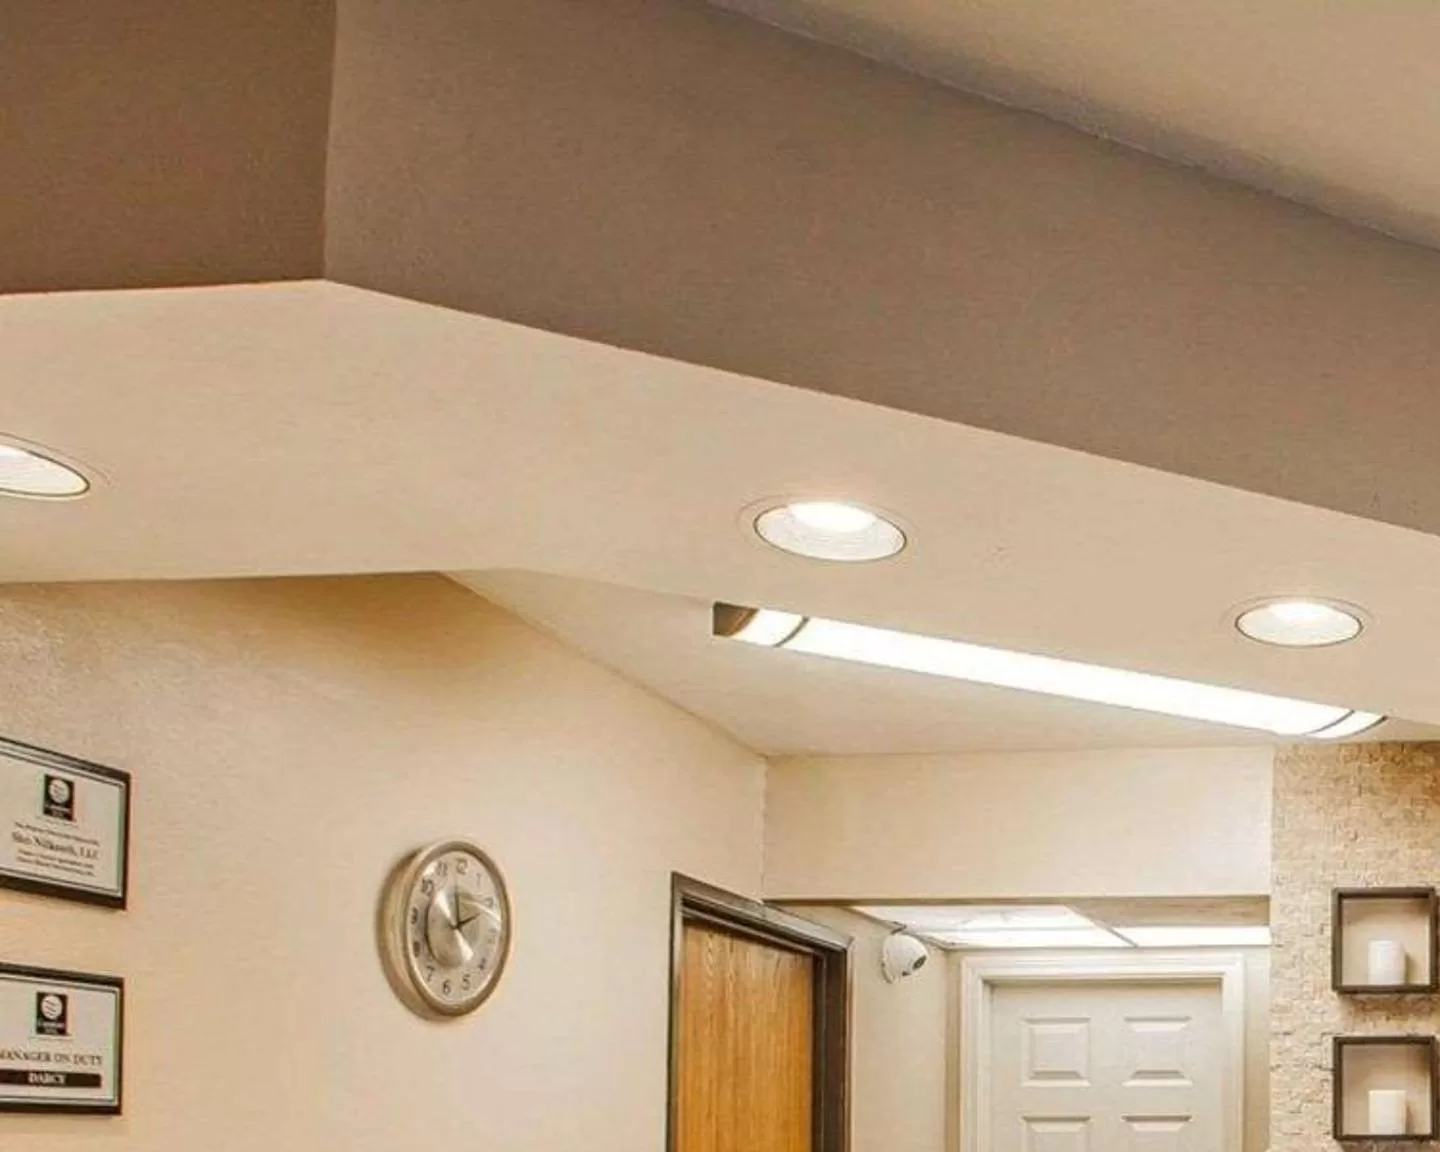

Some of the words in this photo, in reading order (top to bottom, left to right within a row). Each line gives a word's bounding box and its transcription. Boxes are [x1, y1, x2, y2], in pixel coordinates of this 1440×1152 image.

[443, 980, 451, 995] 6
[54, 1053, 71, 1063] ON
[73, 1054, 103, 1066] DUTY
